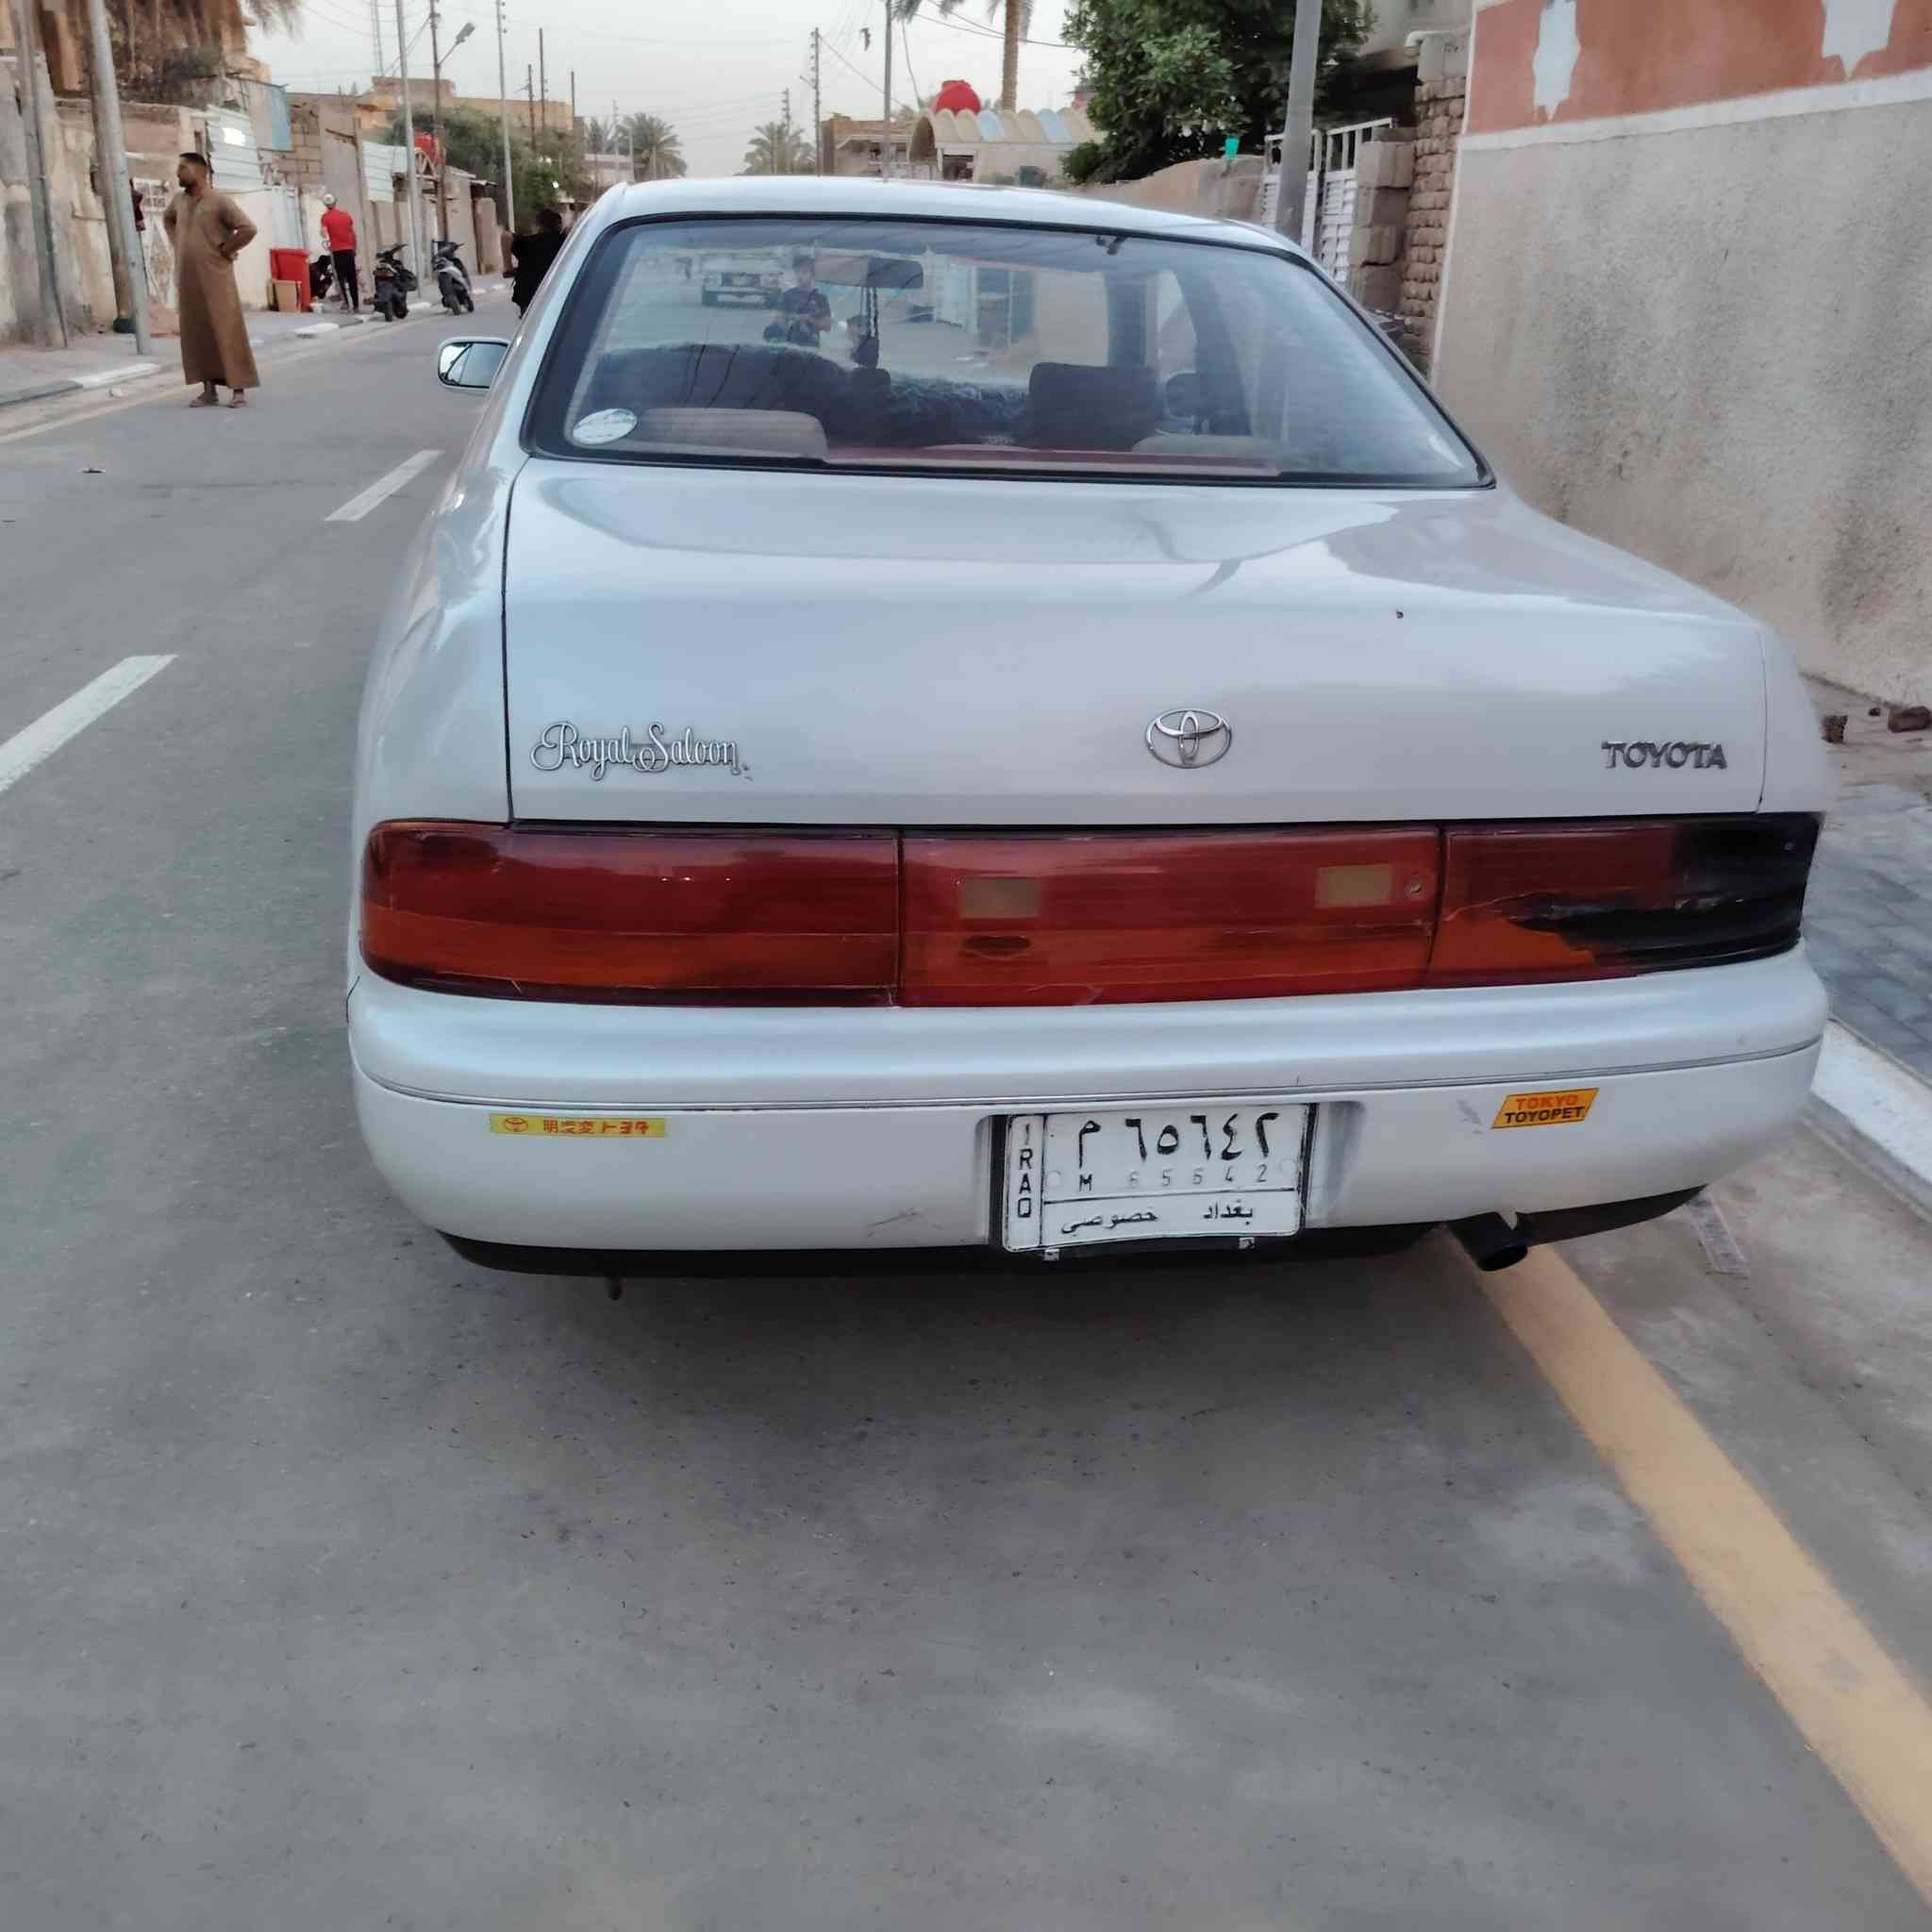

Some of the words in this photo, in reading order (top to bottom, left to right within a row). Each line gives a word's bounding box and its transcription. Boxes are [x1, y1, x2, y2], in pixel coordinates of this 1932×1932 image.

[530, 721, 631, 782] Royal
[631, 721, 741, 775] Saloon
[1601, 741, 1728, 770] TOYOTA
[1504, 1106, 1585, 1124] TOYOPET
[1515, 1093, 1578, 1110] TOKYO
[1017, 1123, 1034, 1220] IRAQ
[1202, 1199, 1254, 1225] بغداد
